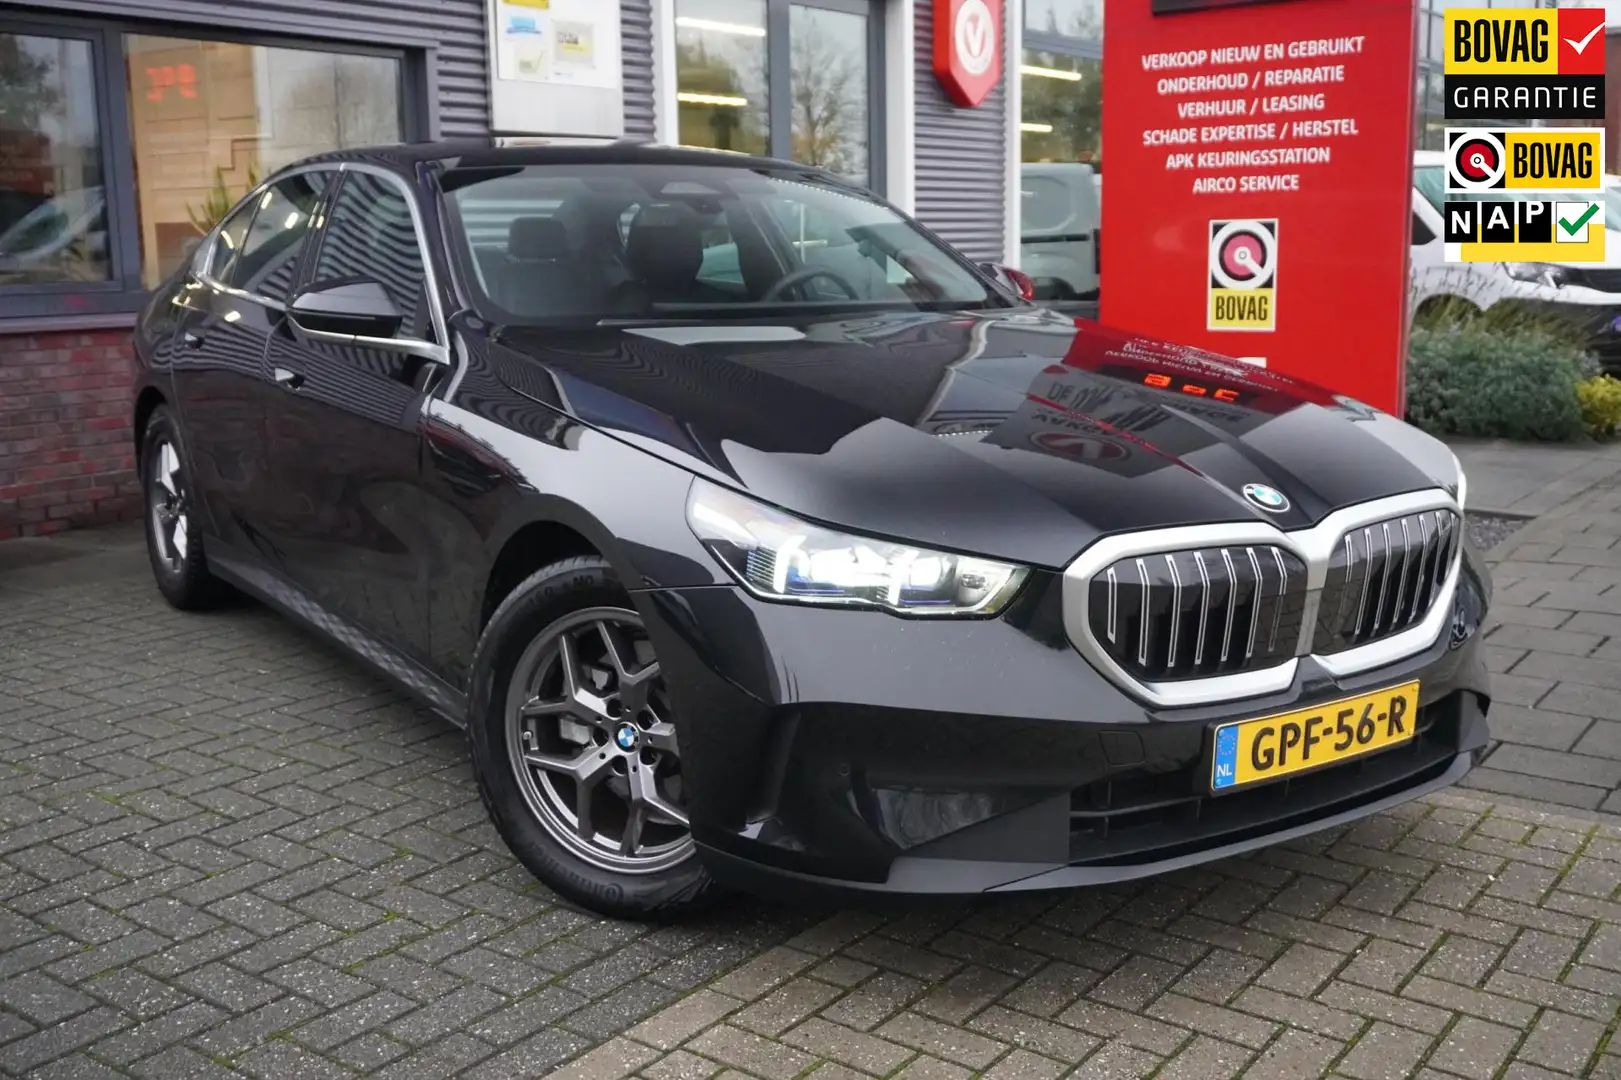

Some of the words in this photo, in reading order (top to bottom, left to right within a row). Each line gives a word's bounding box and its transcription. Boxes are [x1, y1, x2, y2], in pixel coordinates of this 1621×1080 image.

[1142, 50, 1207, 70] VERKOOP
[1211, 45, 1260, 64] NIEUW
[1264, 43, 1284, 60] EN
[1288, 36, 1365, 57] GEBRUIKT
[1157, 73, 1248, 94] ONDERHOUD
[1252, 71, 1261, 89] /
[1265, 65, 1344, 86] REPARATIE
[1177, 98, 1246, 118] VERHUUR
[1250, 98, 1258, 116] /
[1262, 93, 1325, 112] LEASING
[1143, 127, 1197, 146] SCHADE
[1201, 123, 1276, 142] EXPERTISE
[1279, 122, 1288, 140] /
[1292, 118, 1359, 137] HERSTEL
[1165, 153, 1194, 170] APK
[1198, 146, 1330, 168] KEURINGSSTATION
[1192, 176, 1236, 194] AIRCO
[1240, 174, 1299, 193] SERVICE
[1215, 295, 1268, 321] BOVAG
[1251, 695, 1407, 771] GPF-56-R
[1217, 763, 1232, 777] NL
